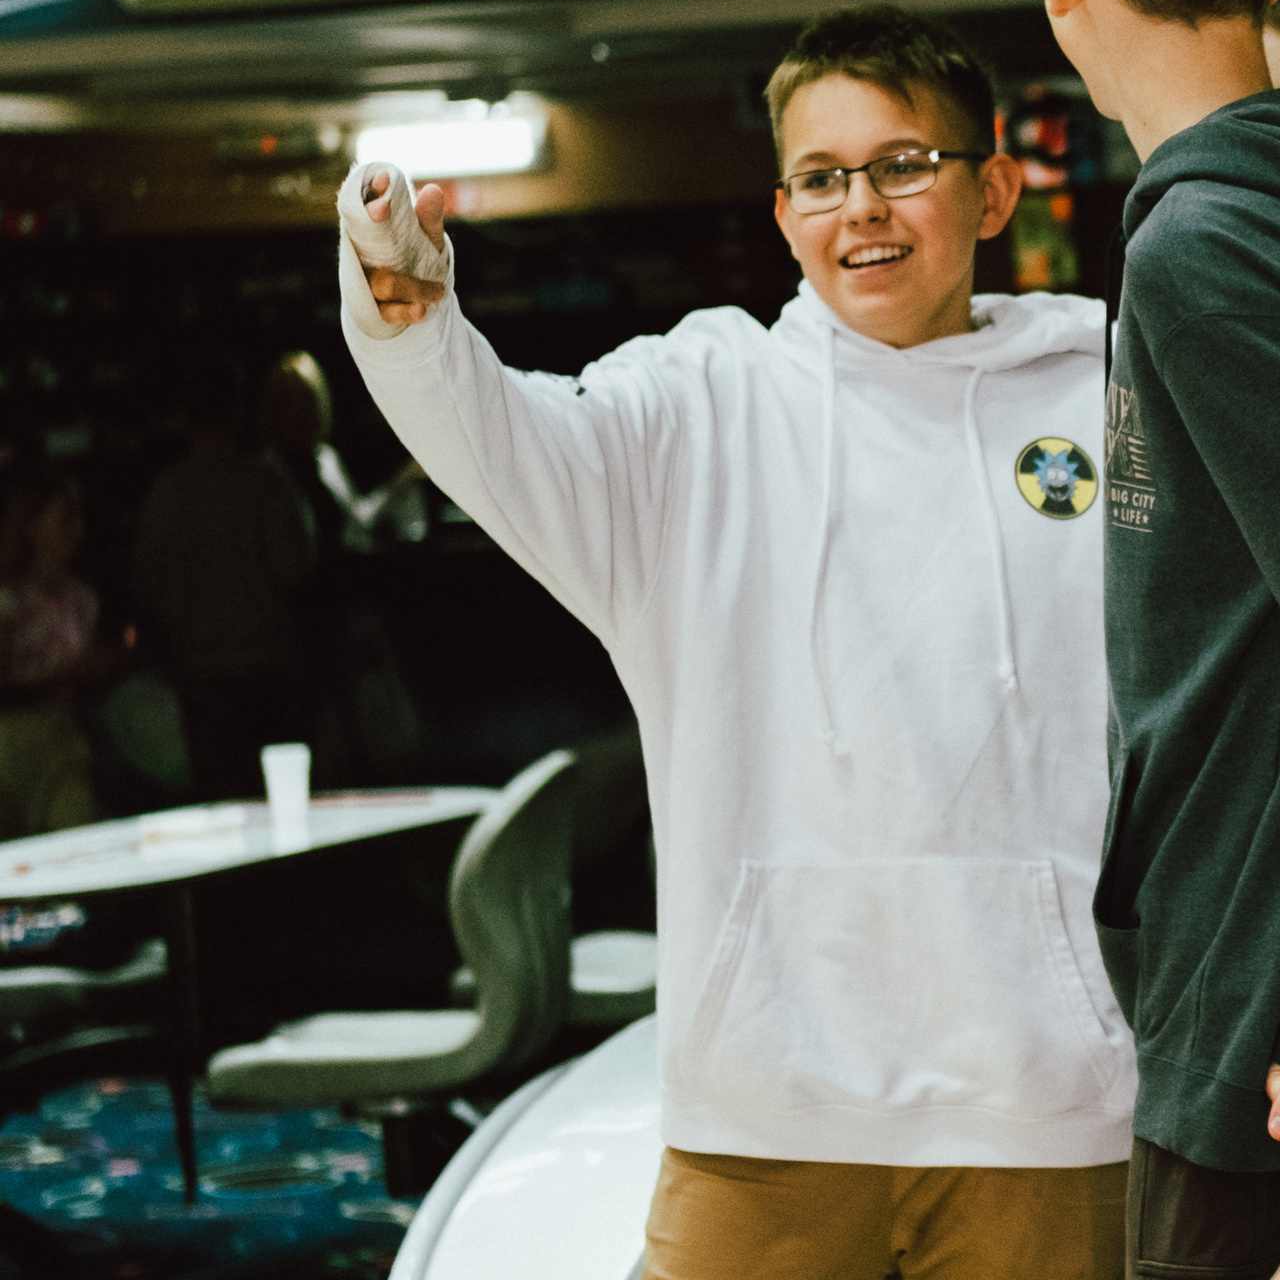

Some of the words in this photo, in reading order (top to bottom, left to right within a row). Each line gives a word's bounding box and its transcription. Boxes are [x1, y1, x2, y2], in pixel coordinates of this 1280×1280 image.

[1111, 488, 1128, 504] BIG
[1133, 493, 1156, 509] CITY
[1121, 508, 1141, 524] LIFE
